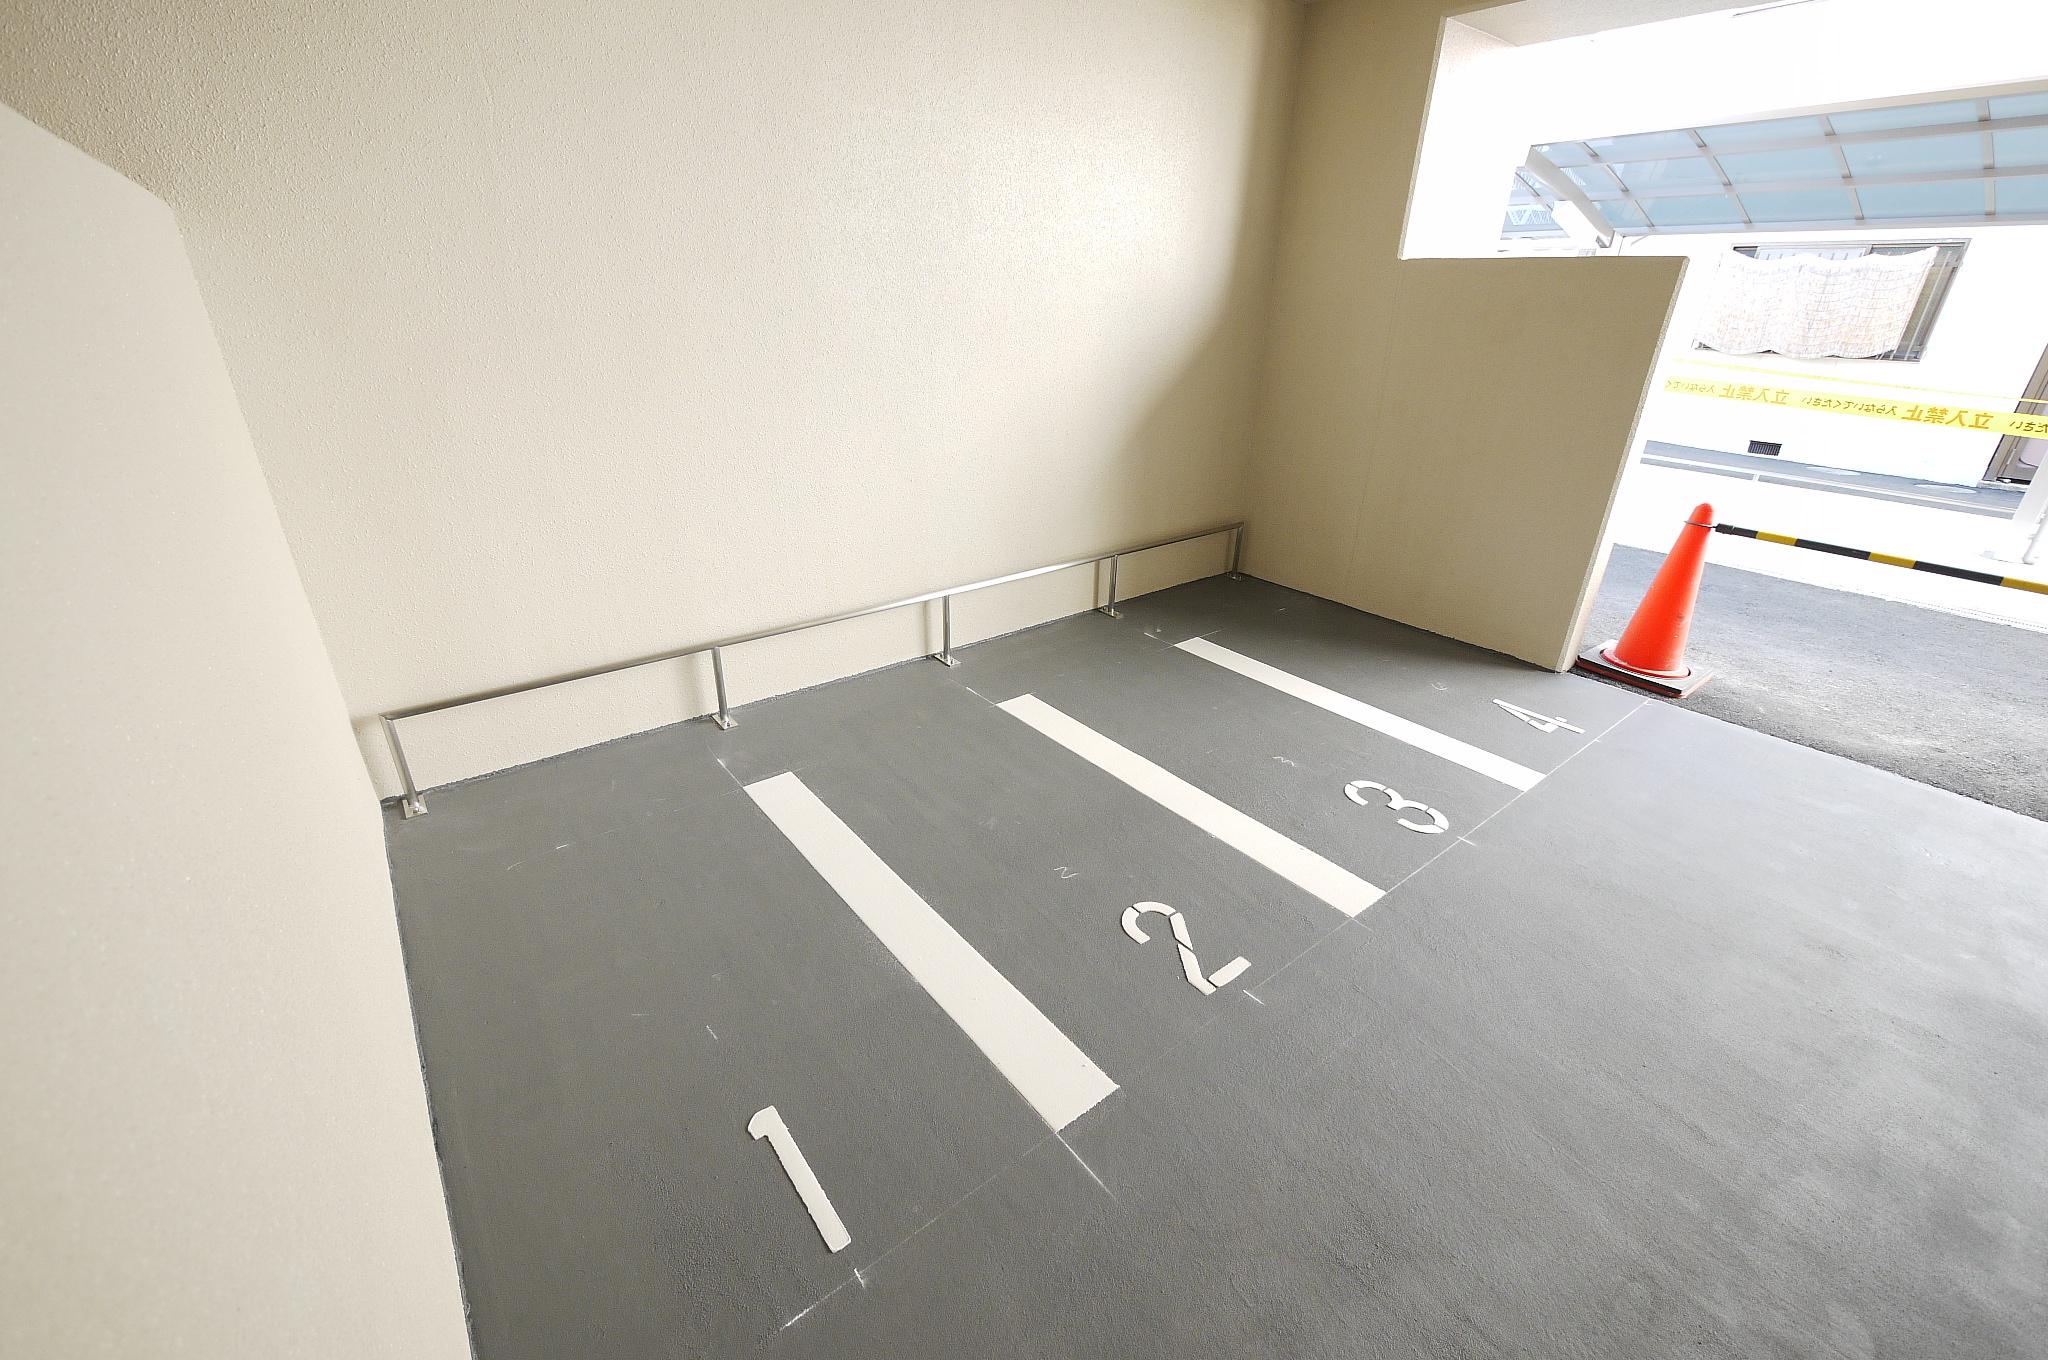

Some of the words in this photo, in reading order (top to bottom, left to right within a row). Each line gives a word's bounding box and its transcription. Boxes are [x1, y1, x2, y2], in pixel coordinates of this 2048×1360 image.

[1492, 699, 1586, 734] 4
[1344, 780, 1449, 834] 3
[1121, 901, 1252, 995] 2
[747, 1105, 851, 1253] 1
